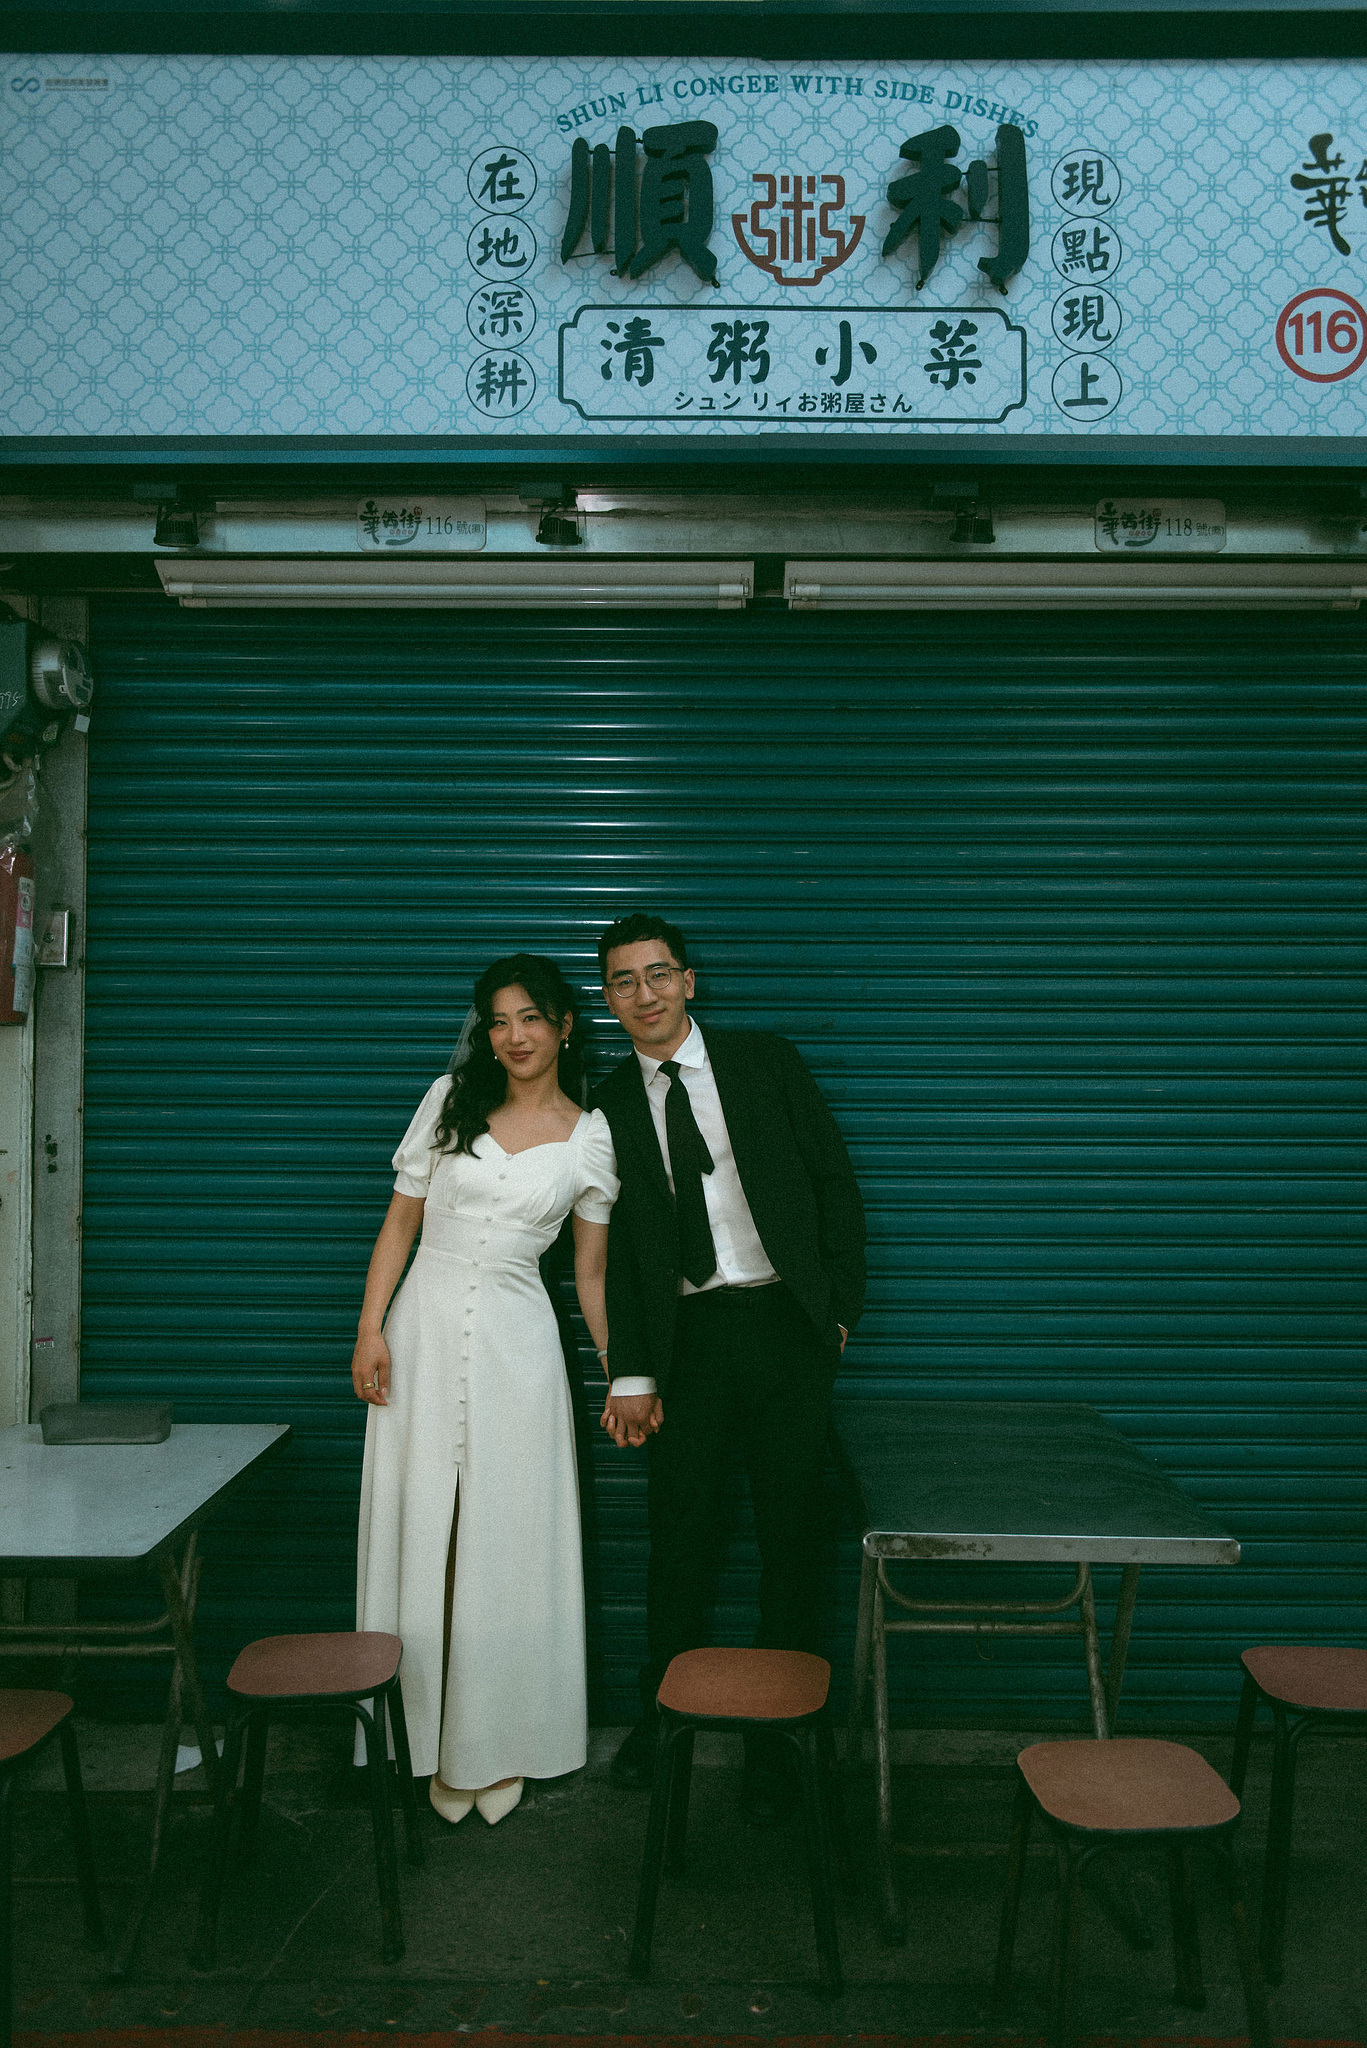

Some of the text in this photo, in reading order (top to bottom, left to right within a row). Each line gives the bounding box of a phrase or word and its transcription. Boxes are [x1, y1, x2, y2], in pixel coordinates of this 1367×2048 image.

[557, 75, 1039, 139] SHUN LI CONGEE WITH SIDE DISHES
[561, 120, 719, 287] 順
[882, 124, 1030, 293] 利
[475, 153, 529, 409] 在地深耕
[1060, 158, 1111, 410] 現點現上
[600, 316, 982, 390] 清粥小菜
[1287, 310, 1358, 357] 116
[426, 516, 453, 534] 116
[1165, 518, 1192, 536] 118
